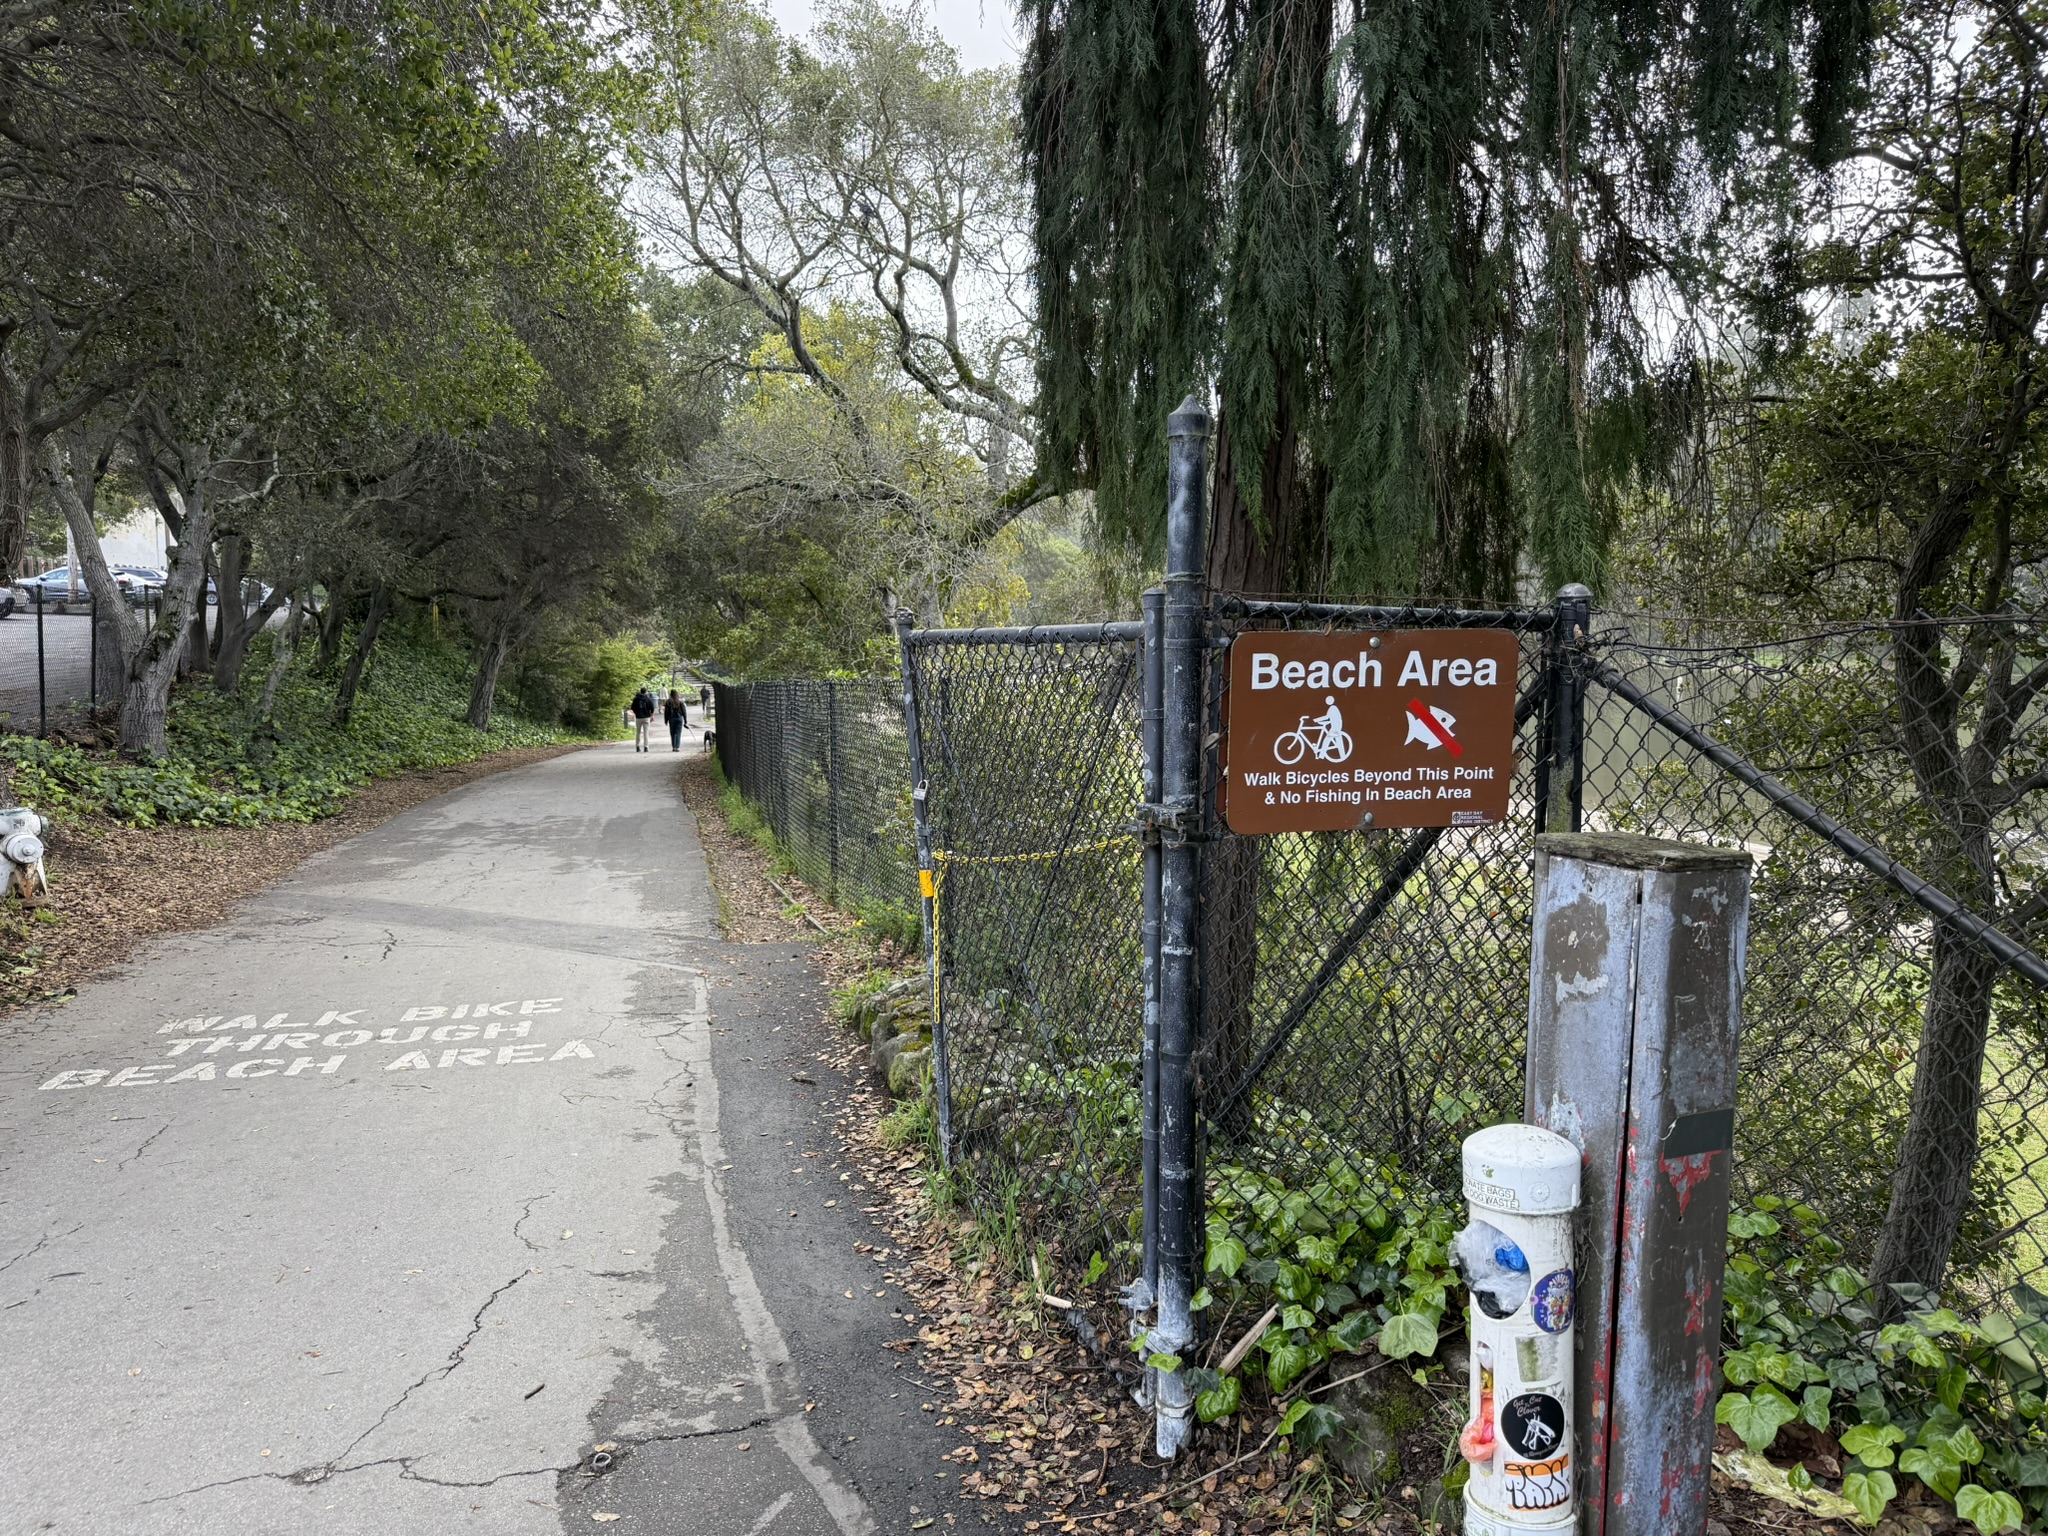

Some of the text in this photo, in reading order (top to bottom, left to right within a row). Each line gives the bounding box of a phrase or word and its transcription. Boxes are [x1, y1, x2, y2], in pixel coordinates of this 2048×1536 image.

[1251, 650, 1497, 690] Beach Area
[1244, 766, 1495, 787] Walk Bicycles Beyond This Point
[1264, 786, 1472, 805] & No Fishing In Beach Area
[156, 997, 564, 1034] WALK BIKE
[164, 1020, 533, 1058] THROUGH
[38, 1038, 596, 1091] BEACH AREA
[1470, 1188, 1485, 1202] DOG
[1485, 1195, 1516, 1209] WASTE
[1486, 1186, 1512, 1199] BAGS
